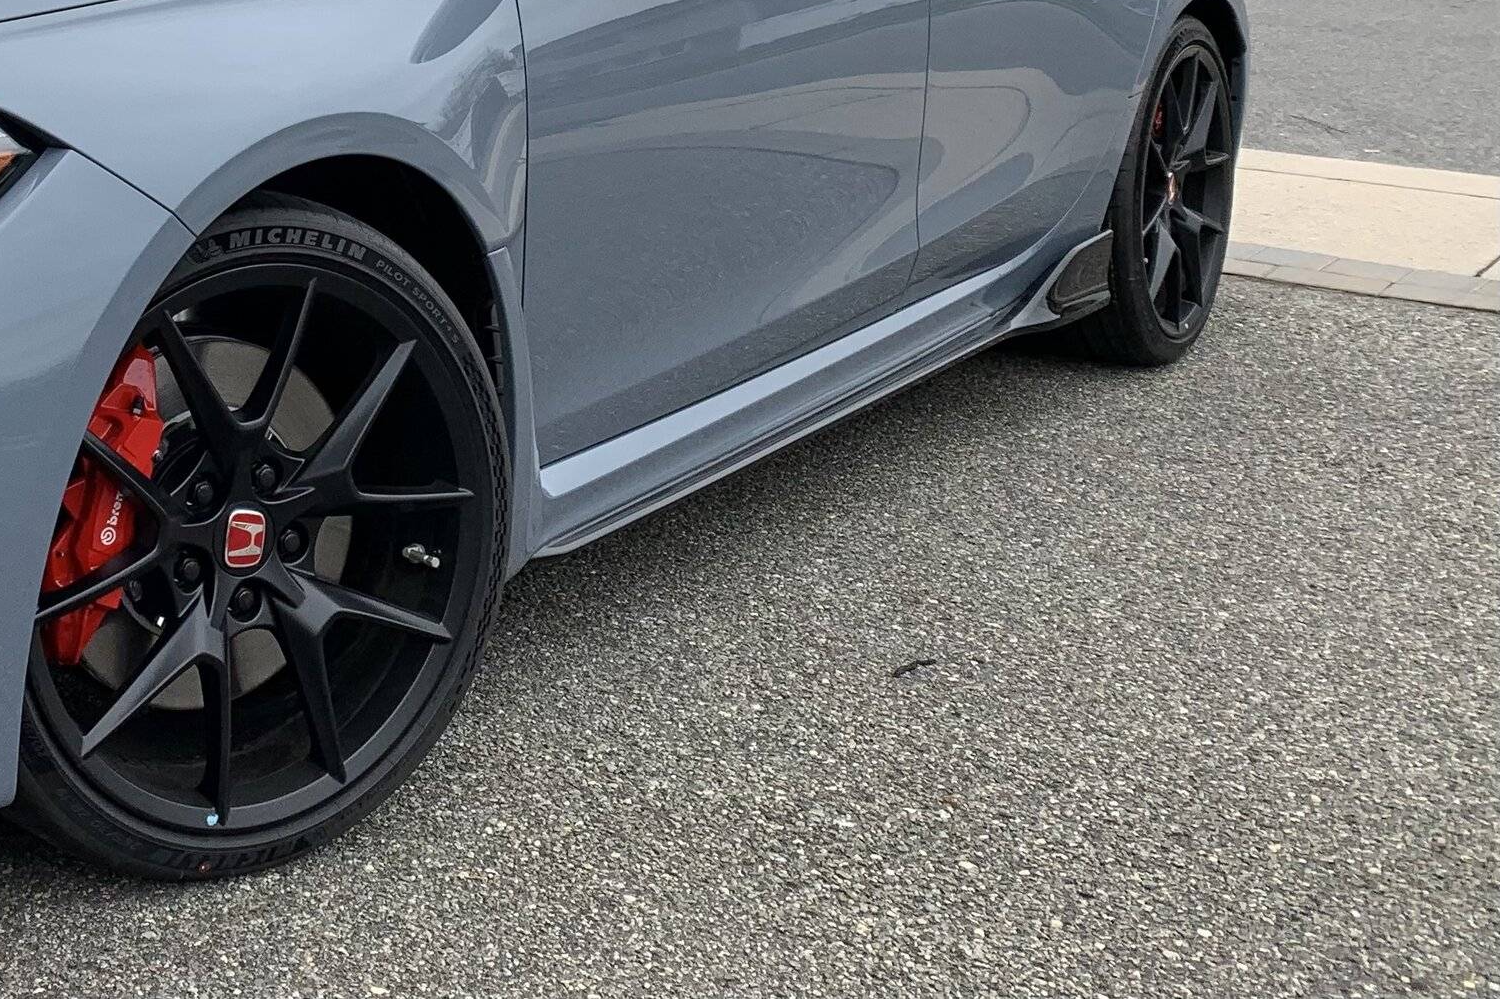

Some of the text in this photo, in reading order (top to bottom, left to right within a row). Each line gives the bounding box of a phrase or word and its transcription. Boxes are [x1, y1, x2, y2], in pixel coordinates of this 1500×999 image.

[228, 227, 367, 261] MICHELIN
[375, 259, 411, 287] PILOT
[412, 287, 448, 325] SPORT
